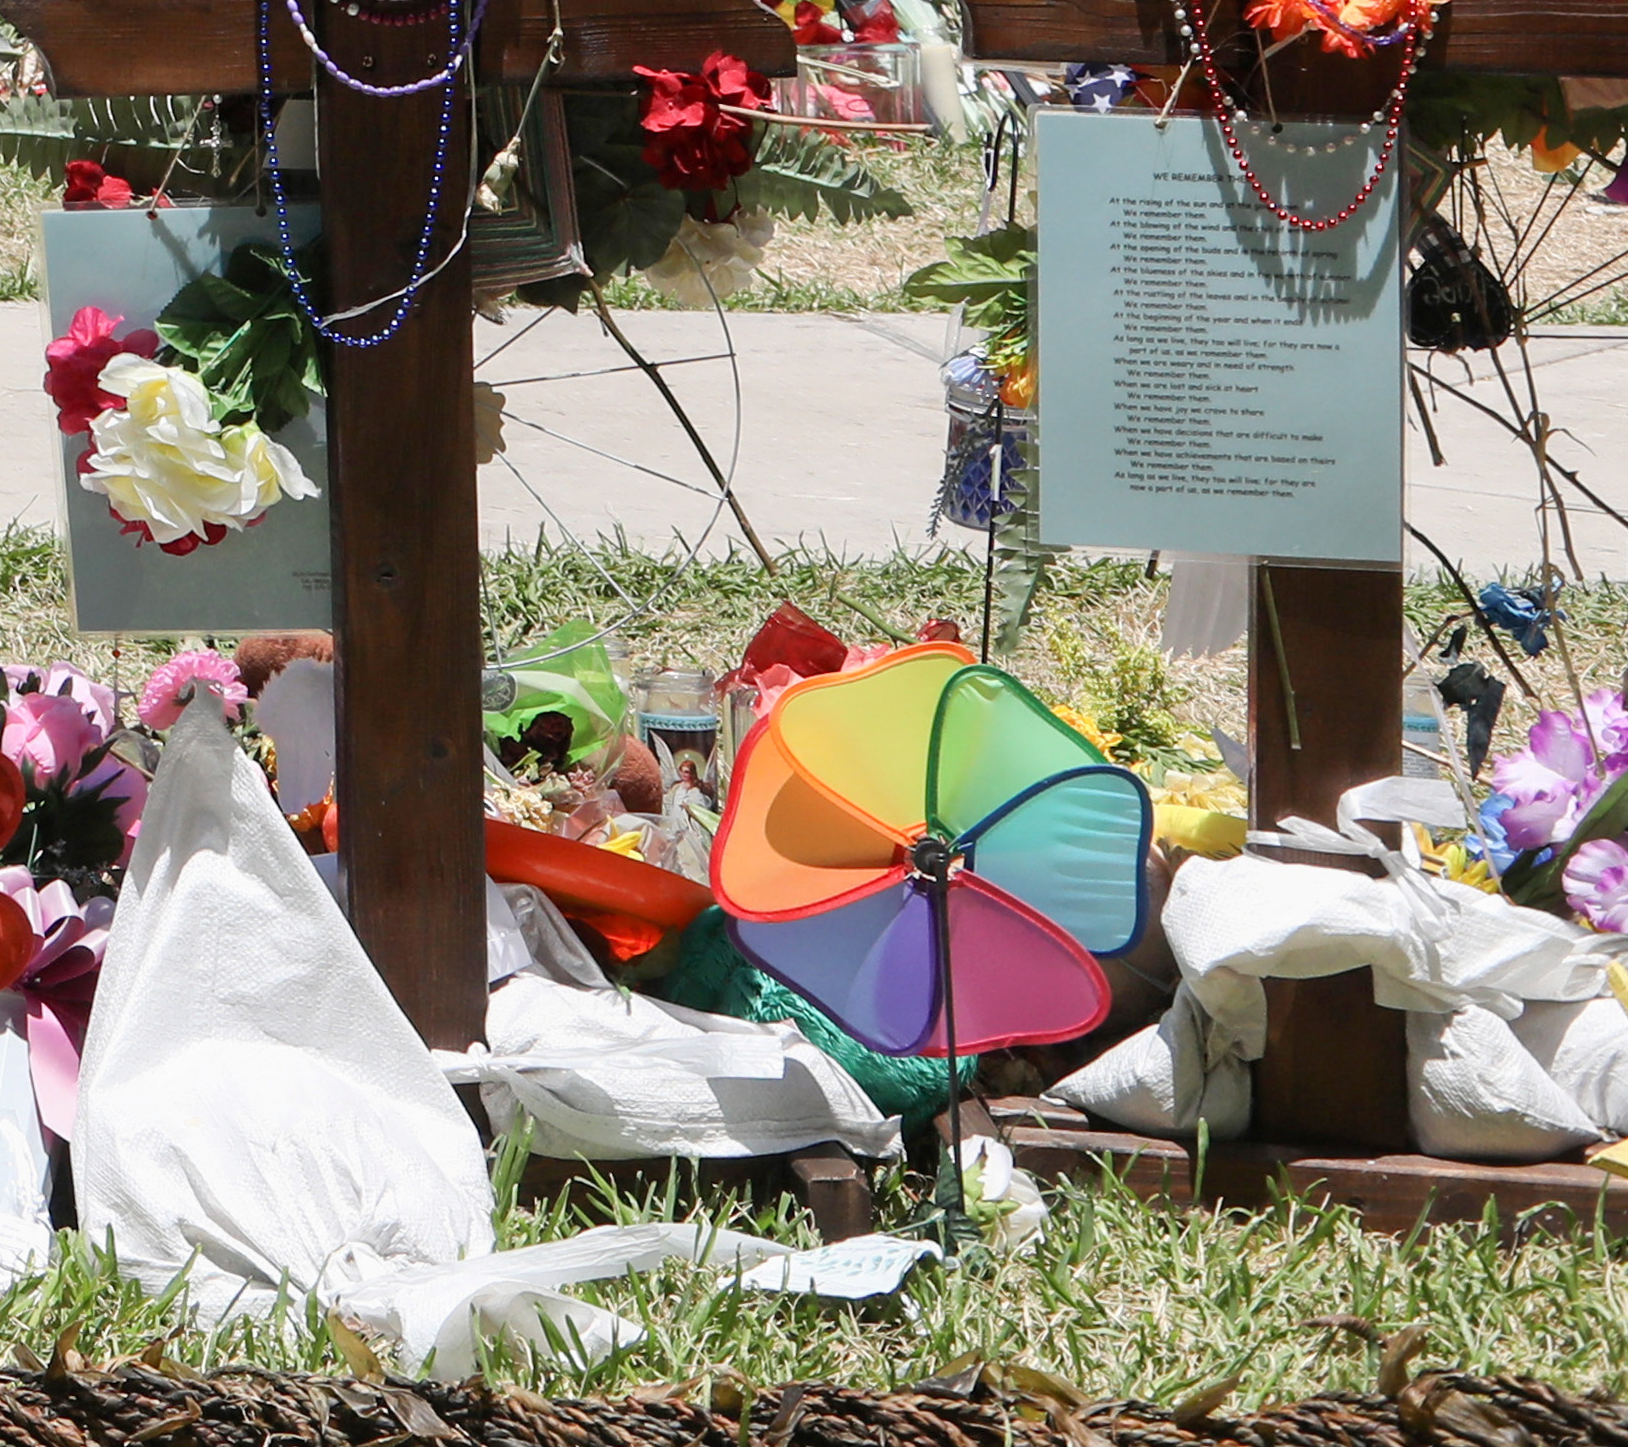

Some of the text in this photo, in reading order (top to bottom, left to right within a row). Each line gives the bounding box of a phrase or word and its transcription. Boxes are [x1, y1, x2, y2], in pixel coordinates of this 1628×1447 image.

[1171, 172, 1224, 183] REMEMBER
[1139, 199, 1162, 210] rising
[1139, 210, 1182, 219] remember
[1139, 221, 1171, 232] blowing
